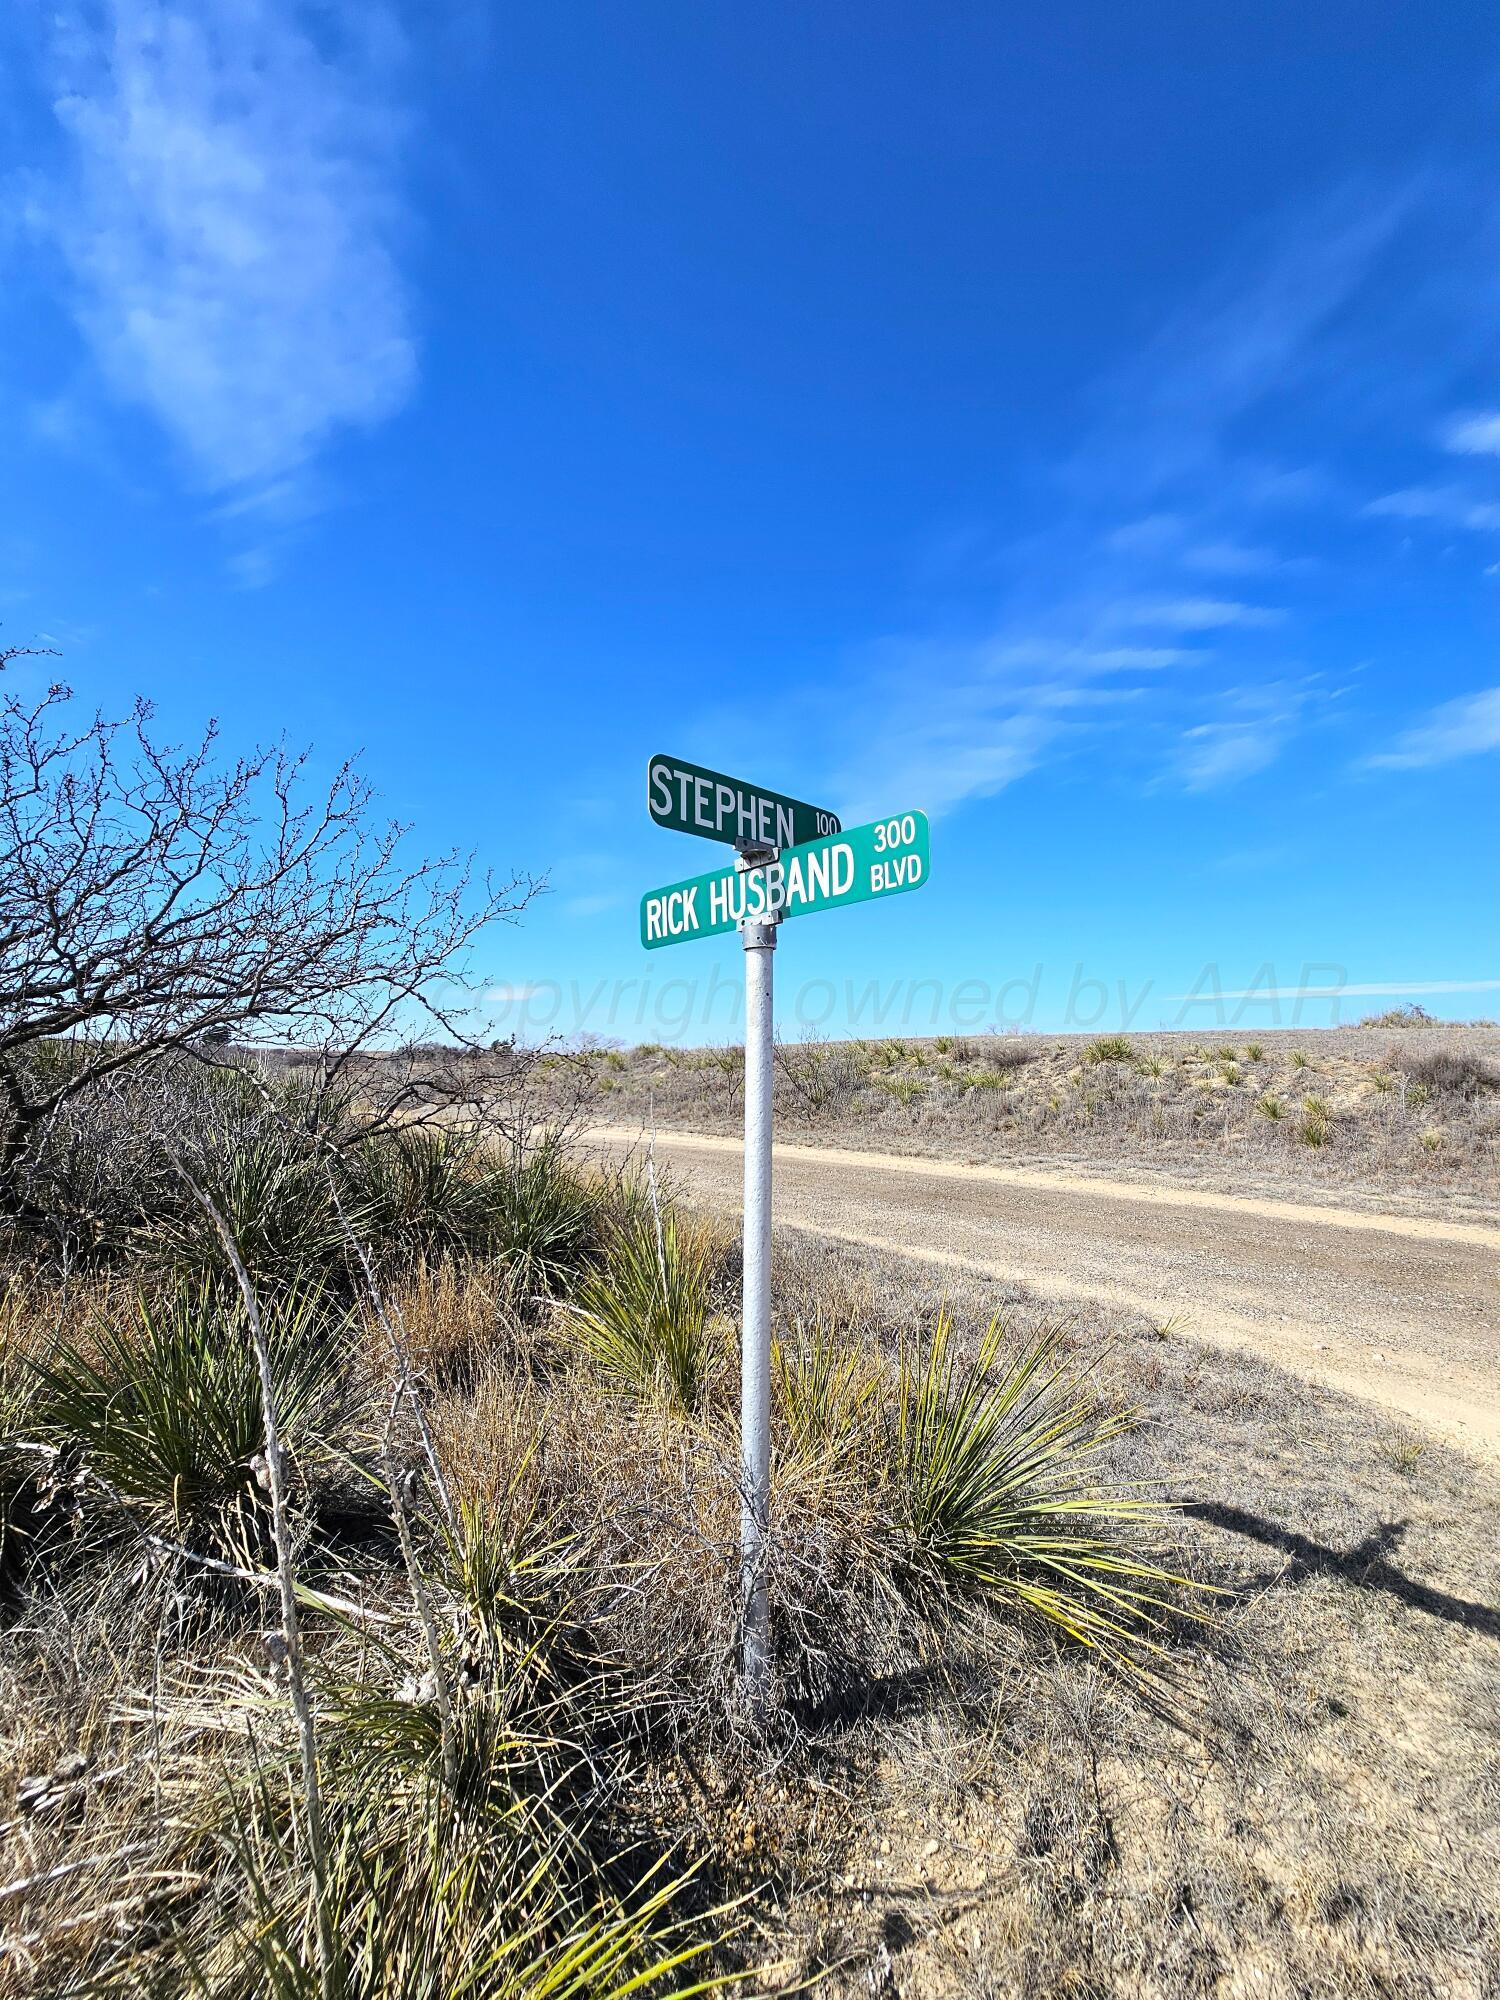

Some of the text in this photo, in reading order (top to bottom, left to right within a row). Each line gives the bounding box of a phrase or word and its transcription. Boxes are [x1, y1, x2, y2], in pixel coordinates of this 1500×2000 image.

[651, 764, 794, 848] STEPHEN
[815, 811, 838, 836] 100
[873, 815, 916, 853] 300
[646, 843, 922, 941] RICK HUSBAND BLVD
